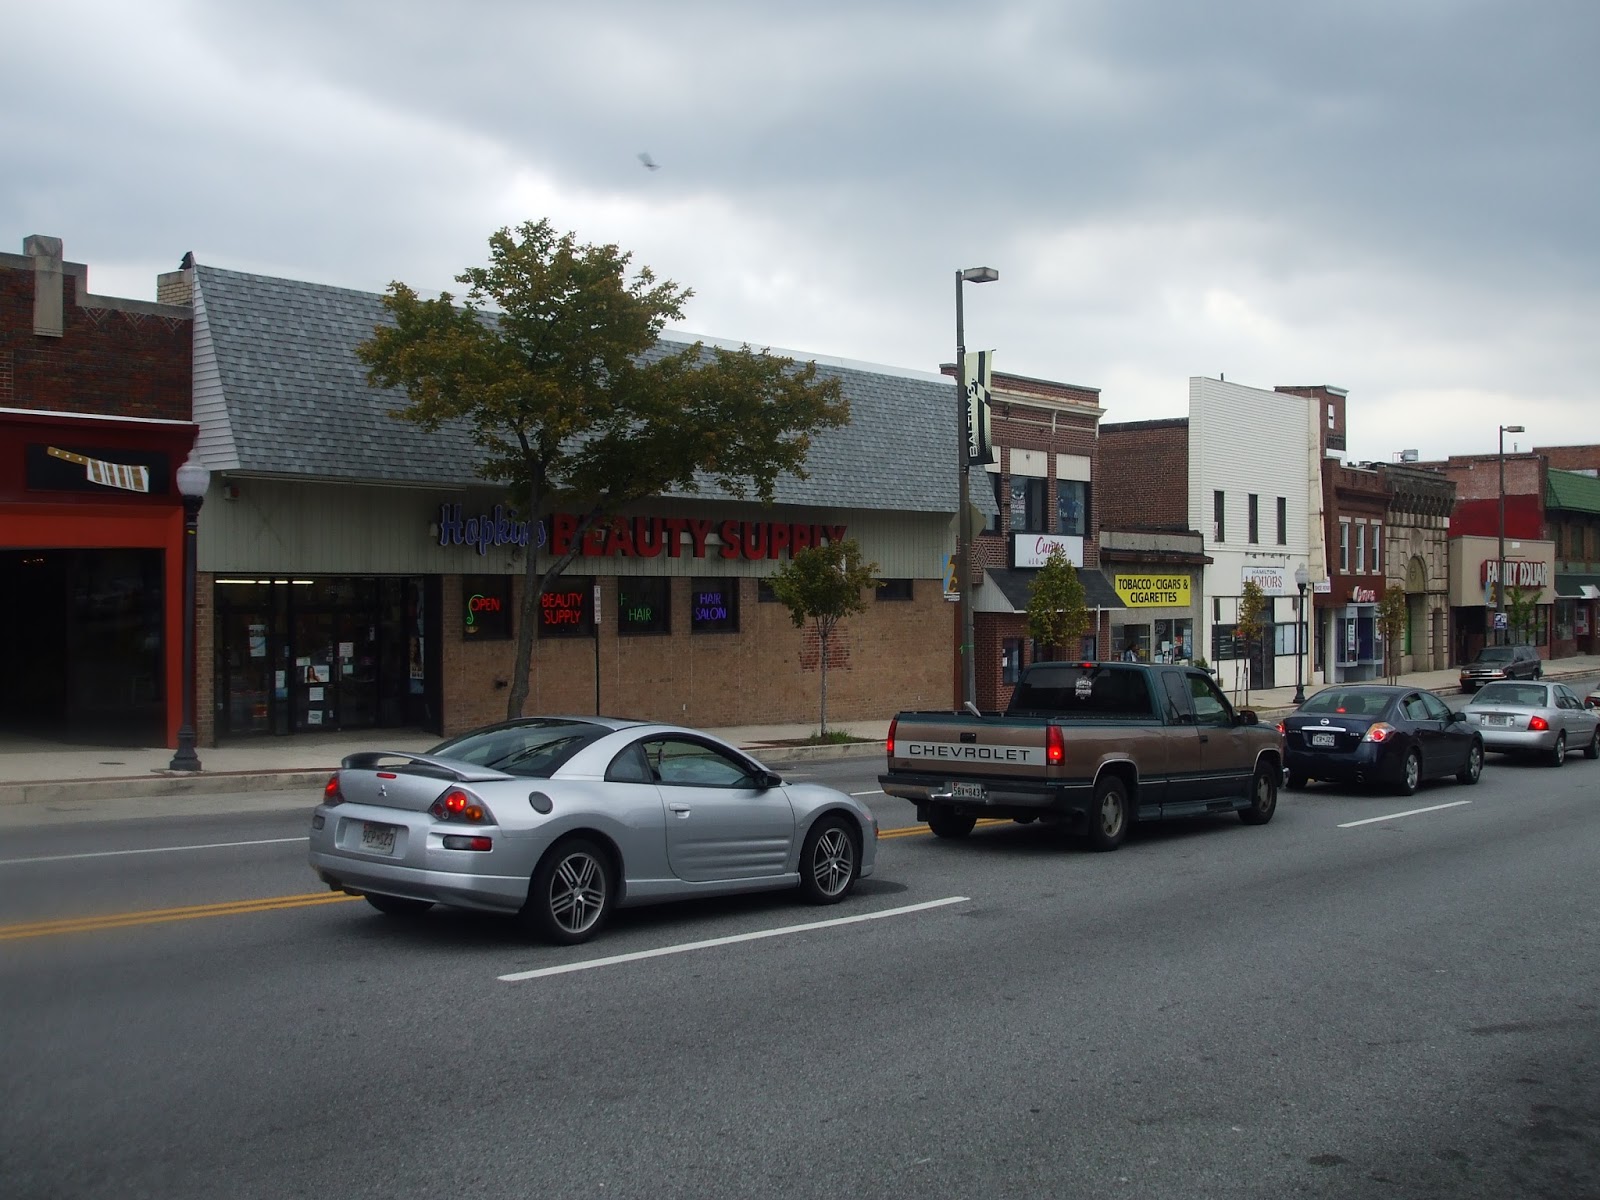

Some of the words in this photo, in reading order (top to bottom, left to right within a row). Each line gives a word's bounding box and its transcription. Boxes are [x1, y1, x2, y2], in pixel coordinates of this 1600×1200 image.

[439, 503, 547, 556] Hopkins
[550, 512, 713, 559] BEAUTY
[1520, 562, 1547, 586] DOLLAR
[1118, 579, 1151, 590] TOBACCO
[1156, 579, 1180, 590] CIGARS
[1183, 580, 1188, 589] &
[471, 597, 501, 612] OPEN
[542, 593, 583, 608] BEAUTY
[698, 592, 720, 605] HAIR
[1130, 592, 1177, 603] CIGARETTES
[544, 609, 582, 624] SUPPLY
[628, 607, 652, 621] HAIR
[694, 607, 726, 620] SALON
[909, 744, 1030, 761] CHEVROLET
